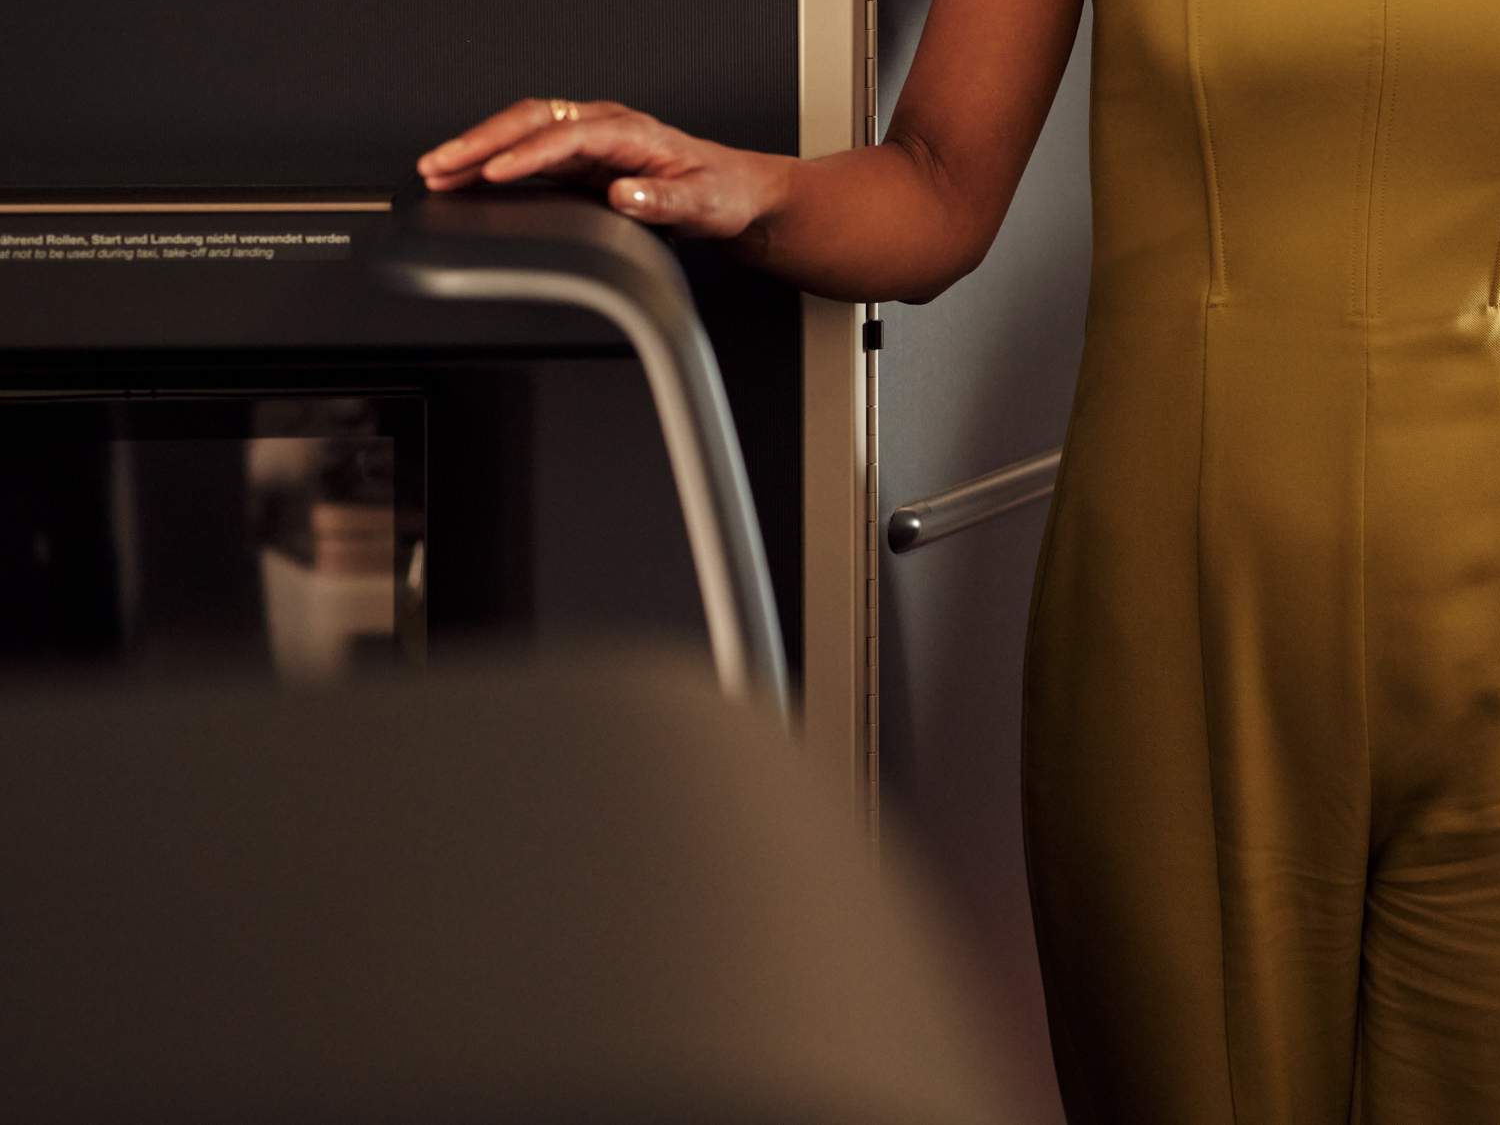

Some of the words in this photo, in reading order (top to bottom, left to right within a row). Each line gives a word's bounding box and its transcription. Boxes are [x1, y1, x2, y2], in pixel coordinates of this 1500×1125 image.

[46, 235, 88, 246] Rollen,
[91, 235, 122, 245] Start
[125, 235, 148, 245] und
[151, 235, 204, 247] Landung
[206, 234, 237, 244] nicht
[240, 234, 302, 244] verwendet
[305, 234, 350, 244] werden
[12, 249, 32, 259] not
[34, 249, 47, 259] to
[48, 249, 65, 259] be
[66, 249, 95, 259] used
[97, 249, 134, 261] during
[136, 249, 159, 260] taxi,
[163, 248, 207, 259] take-off
[208, 248, 231, 258] and
[232, 248, 275, 260] landing
